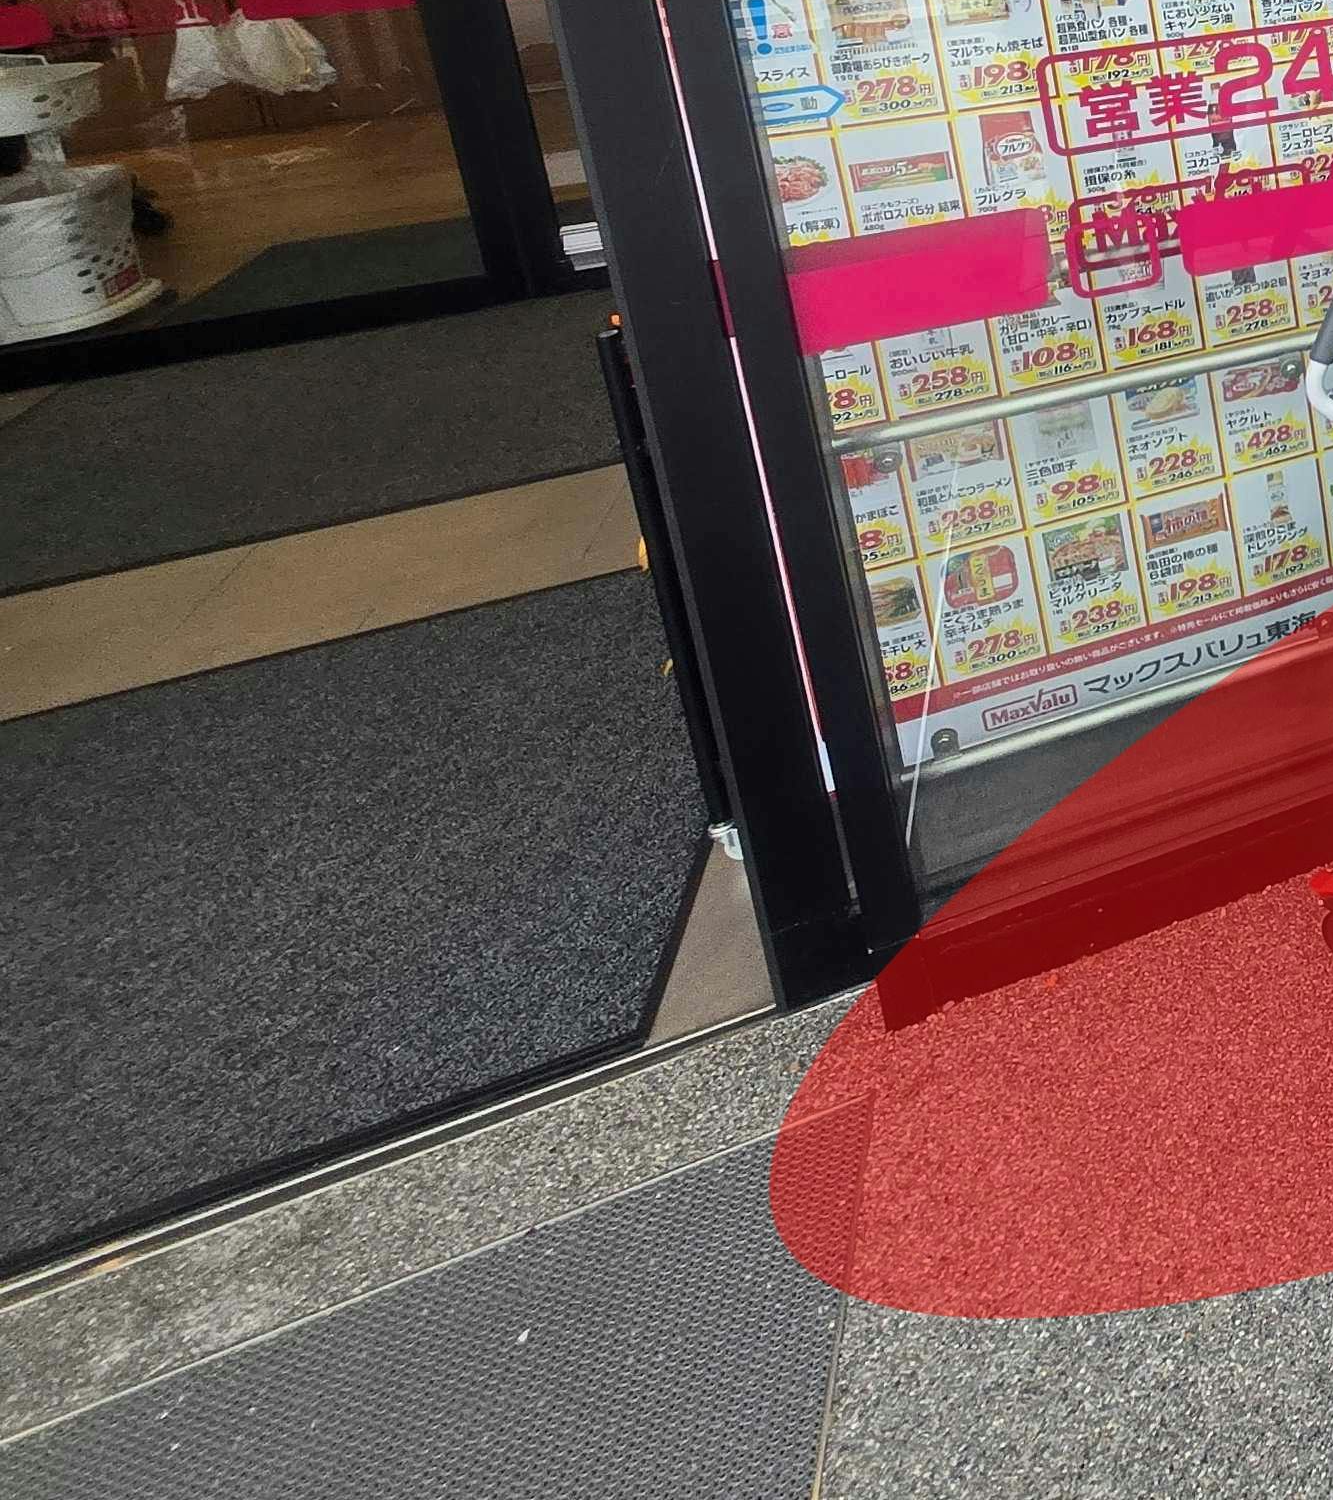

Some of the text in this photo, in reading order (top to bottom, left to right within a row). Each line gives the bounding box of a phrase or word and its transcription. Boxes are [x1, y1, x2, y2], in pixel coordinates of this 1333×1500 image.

[975, 188, 1027, 205] フルグラ
[1105, 299, 1186, 323] カップヌードル
[990, 688, 1072, 726] MaxValu
